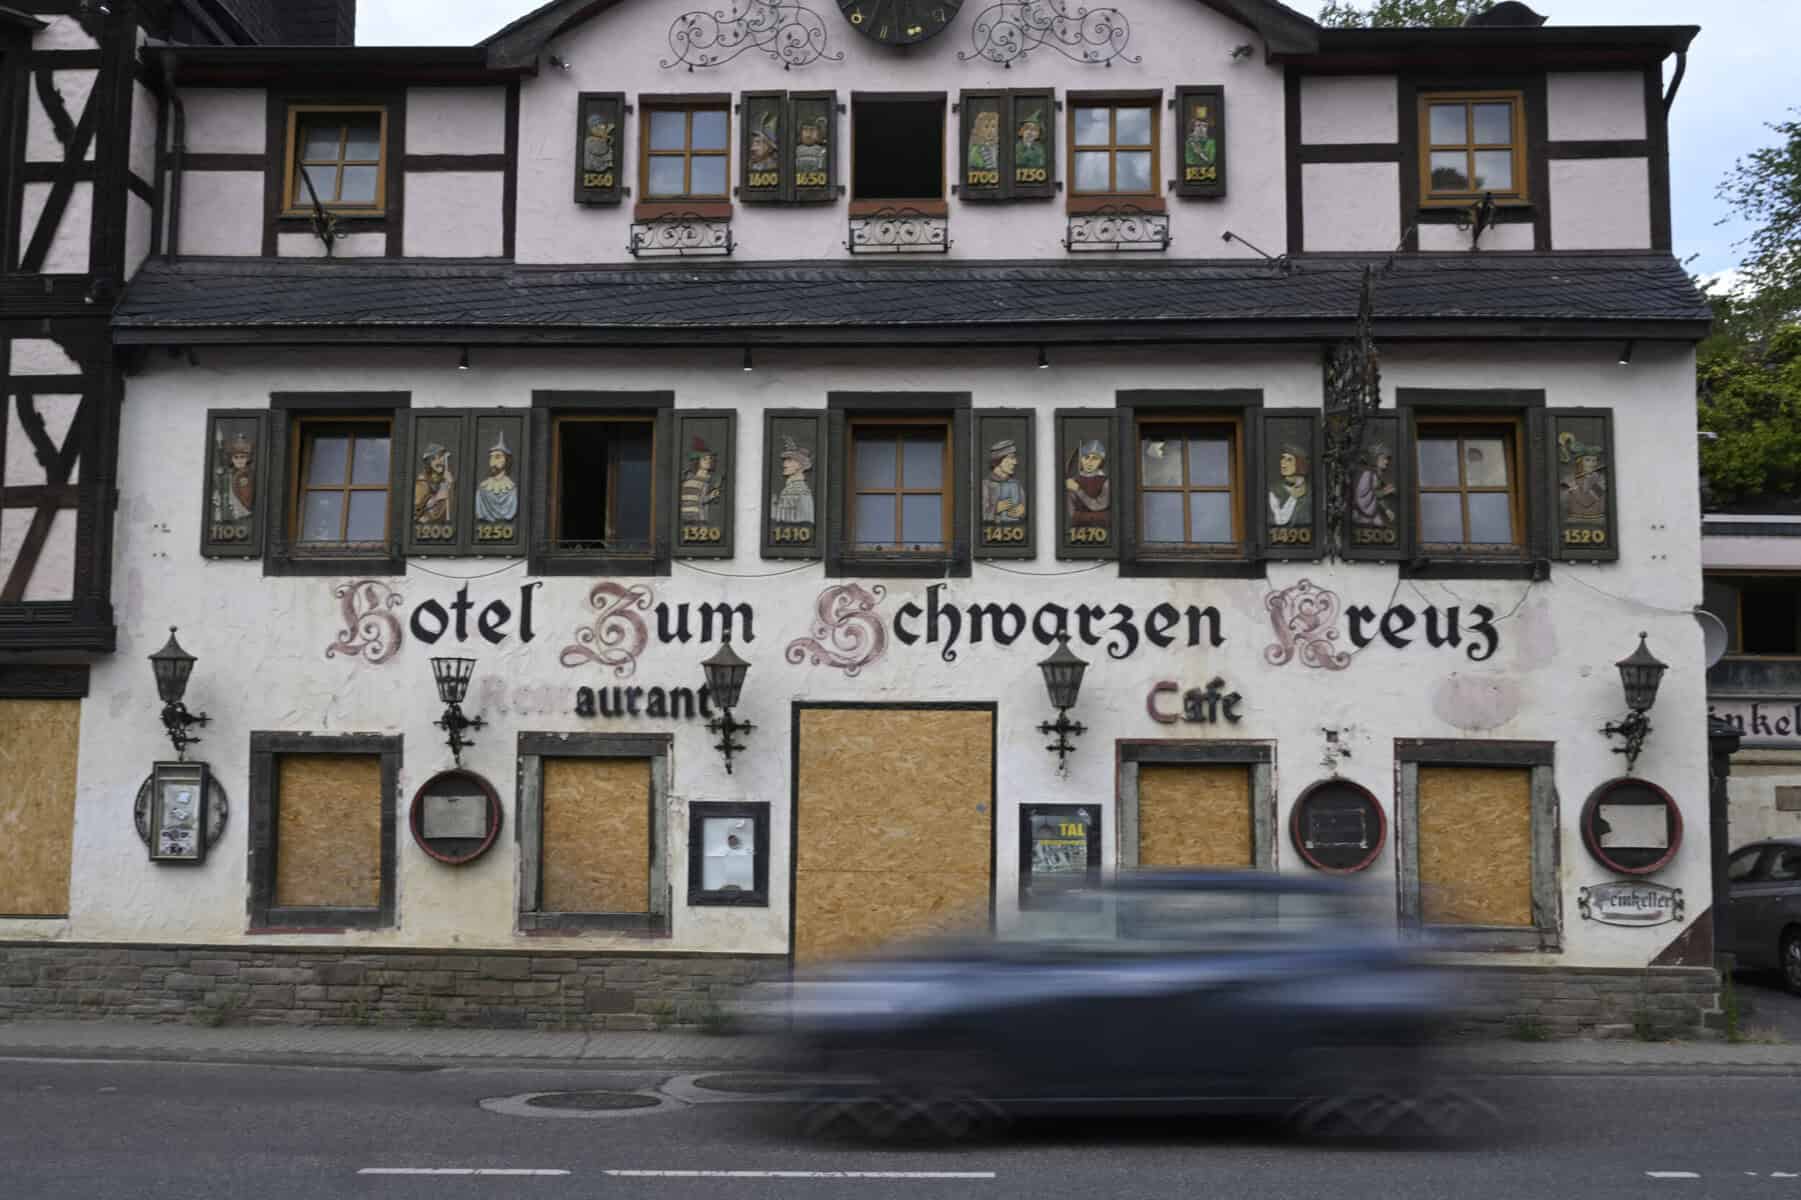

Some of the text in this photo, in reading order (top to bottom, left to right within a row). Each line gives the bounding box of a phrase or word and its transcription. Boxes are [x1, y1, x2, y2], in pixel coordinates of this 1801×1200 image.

[750, 174, 779, 187] 1600
[795, 174, 827, 187] 1650
[967, 171, 999, 184] 1700
[1016, 169, 1047, 183] 1750
[1185, 167, 1217, 181] 1834
[211, 527, 247, 541] 1100
[415, 526, 452, 540] 1200
[479, 526, 512, 540] 1250
[684, 527, 721, 541] 1320
[773, 527, 810, 542] 1410
[985, 527, 1023, 542] 1450
[1069, 527, 1106, 542] 1470
[1270, 529, 1311, 543] 1490
[1357, 529, 1395, 543] 1500
[1564, 529, 1605, 544] 1520
[325, 578, 1499, 677] Hotel Zum Schwarzen Kreuz
[1060, 823, 1085, 837] TAL
